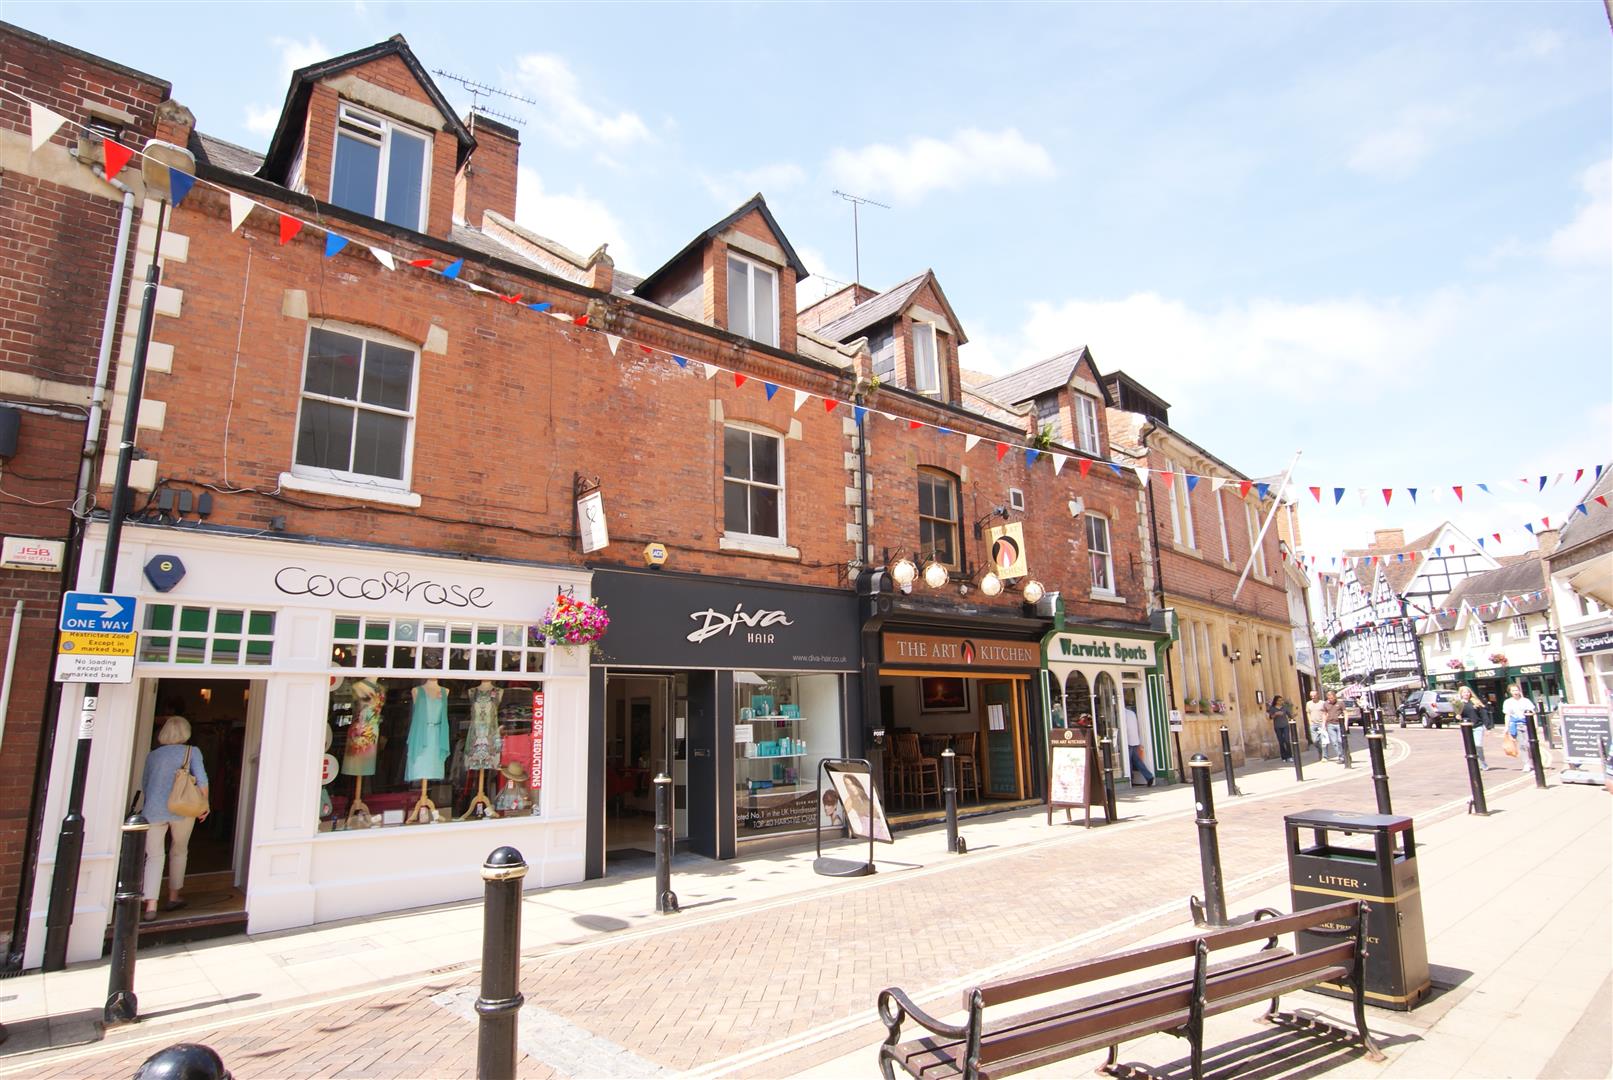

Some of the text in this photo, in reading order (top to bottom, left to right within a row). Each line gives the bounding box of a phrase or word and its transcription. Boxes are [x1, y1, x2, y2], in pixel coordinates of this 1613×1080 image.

[17, 547, 50, 556] JSB
[66, 618, 129, 630] ONE WAY
[686, 602, 795, 644] Diva
[69, 631, 110, 639] Restricted
[747, 632, 775, 644] HAIR
[896, 640, 1033, 661] THE ART KITCHEN
[1059, 637, 1148, 662] Warwick Sports
[89, 658, 117, 666] loading
[792, 654, 848, 664] www.diva-hair.co.uk
[87, 698, 95, 708] 2
[532, 694, 544, 787] UP TO 50% REDUCTIONS
[1318, 874, 1360, 888] LITTER
